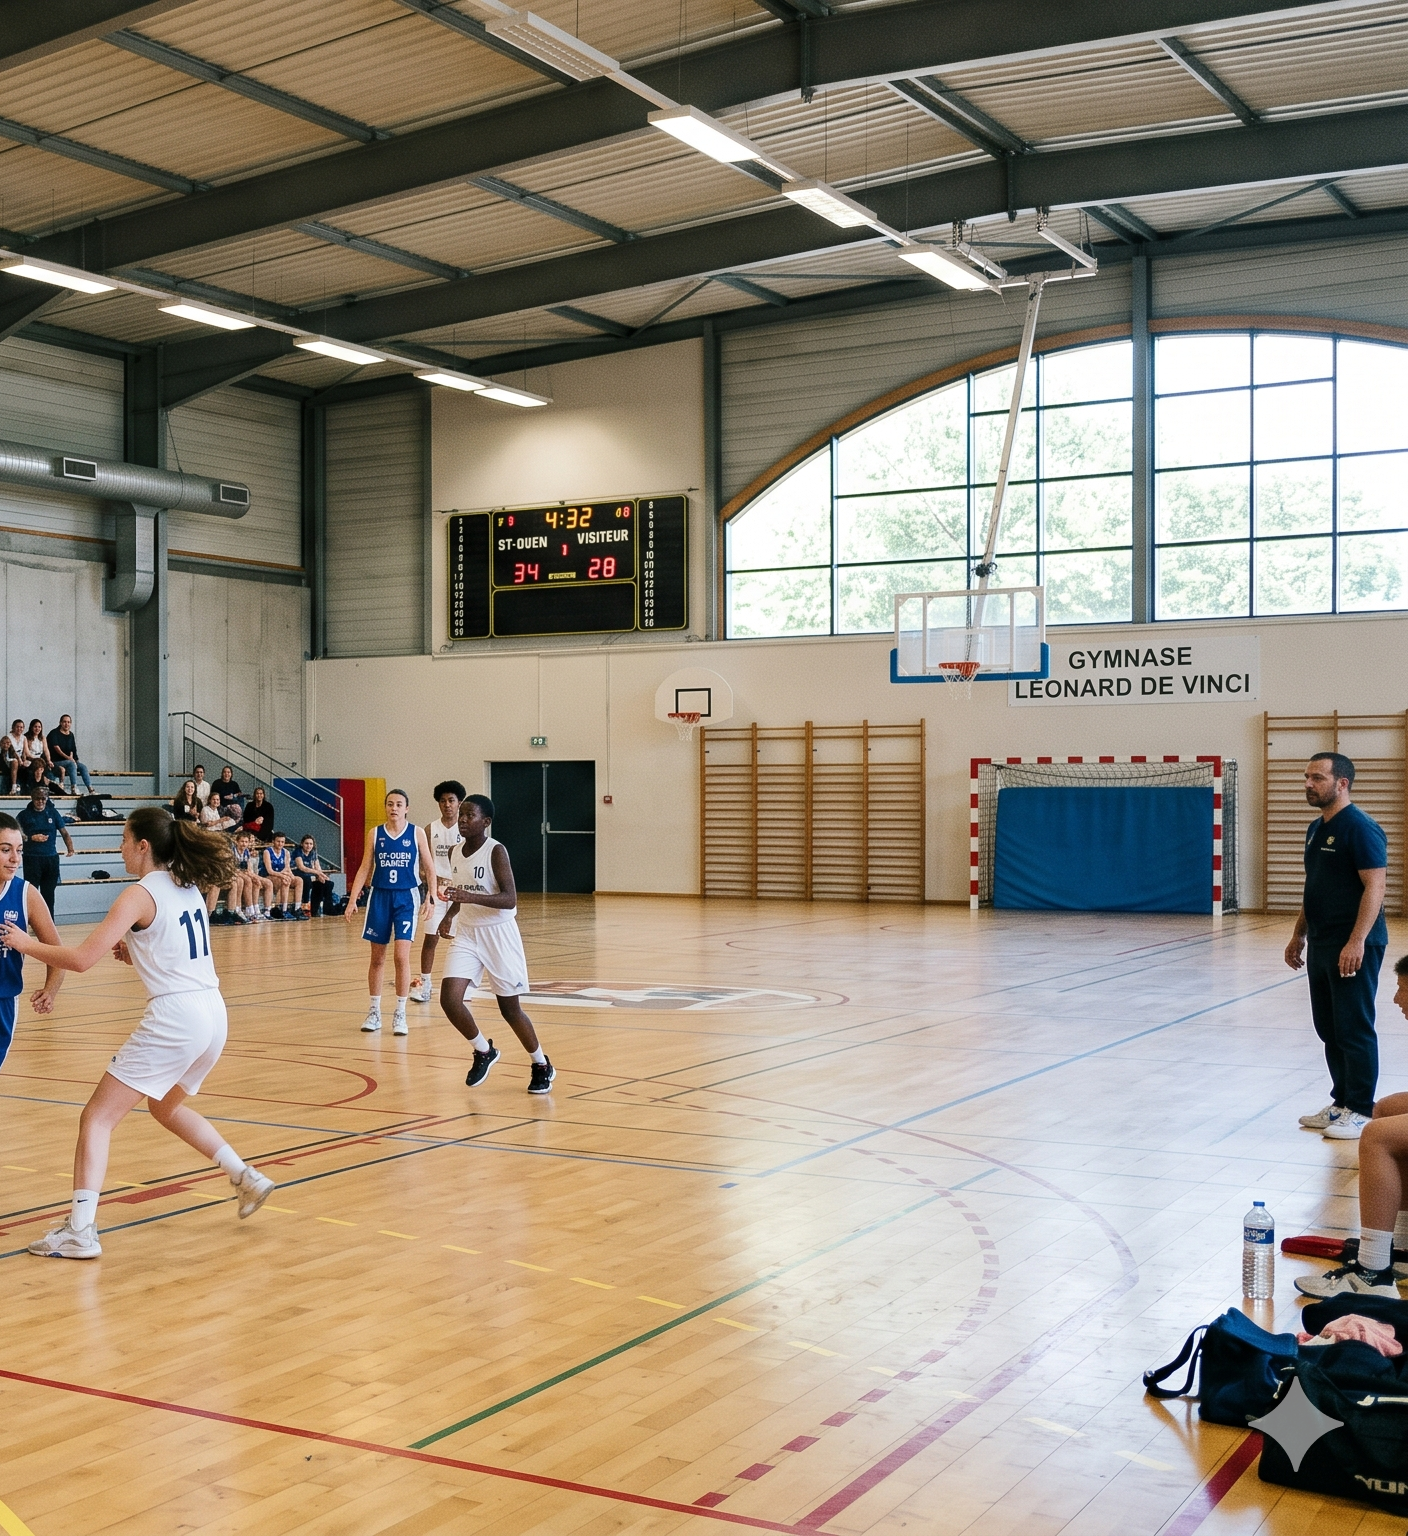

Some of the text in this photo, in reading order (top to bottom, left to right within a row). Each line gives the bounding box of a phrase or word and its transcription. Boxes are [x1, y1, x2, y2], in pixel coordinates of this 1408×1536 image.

[545, 507, 592, 529] 4:32
[498, 536, 548, 551] ST-OUEN
[577, 529, 629, 545] VISITEUR
[514, 563, 539, 583] 34
[588, 557, 615, 579] 28
[1069, 647, 1192, 670] GYMNASE
[1141, 676, 1174, 696] DE
[1182, 673, 1250, 695] VINCI
[389, 869, 397, 884] 9
[473, 866, 485, 879] 10
[179, 908, 209, 960] 11
[403, 920, 412, 934] 7
